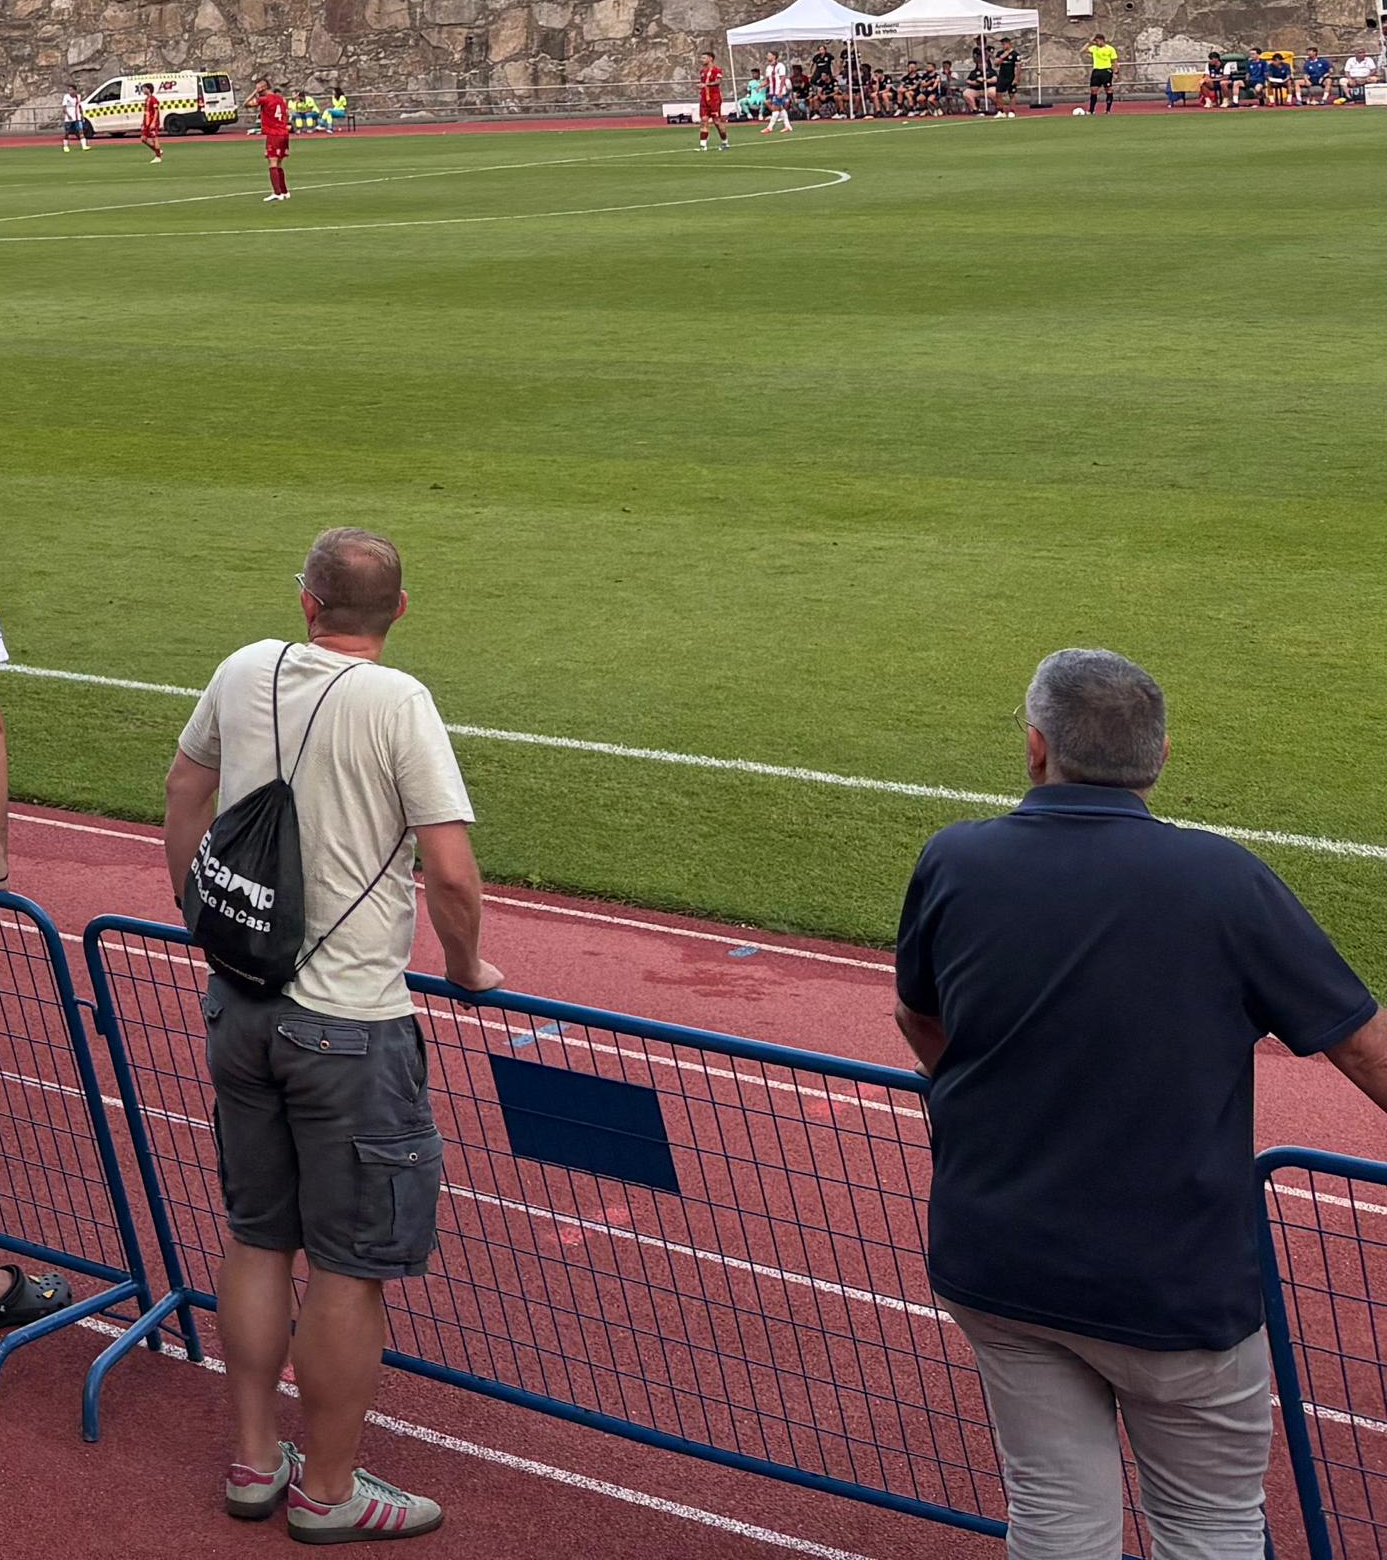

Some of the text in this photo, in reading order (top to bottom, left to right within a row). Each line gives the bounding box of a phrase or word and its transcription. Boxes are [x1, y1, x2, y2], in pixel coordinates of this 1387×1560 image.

[274, 104, 283, 121] 4
[200, 889, 272, 933] de la Casa
